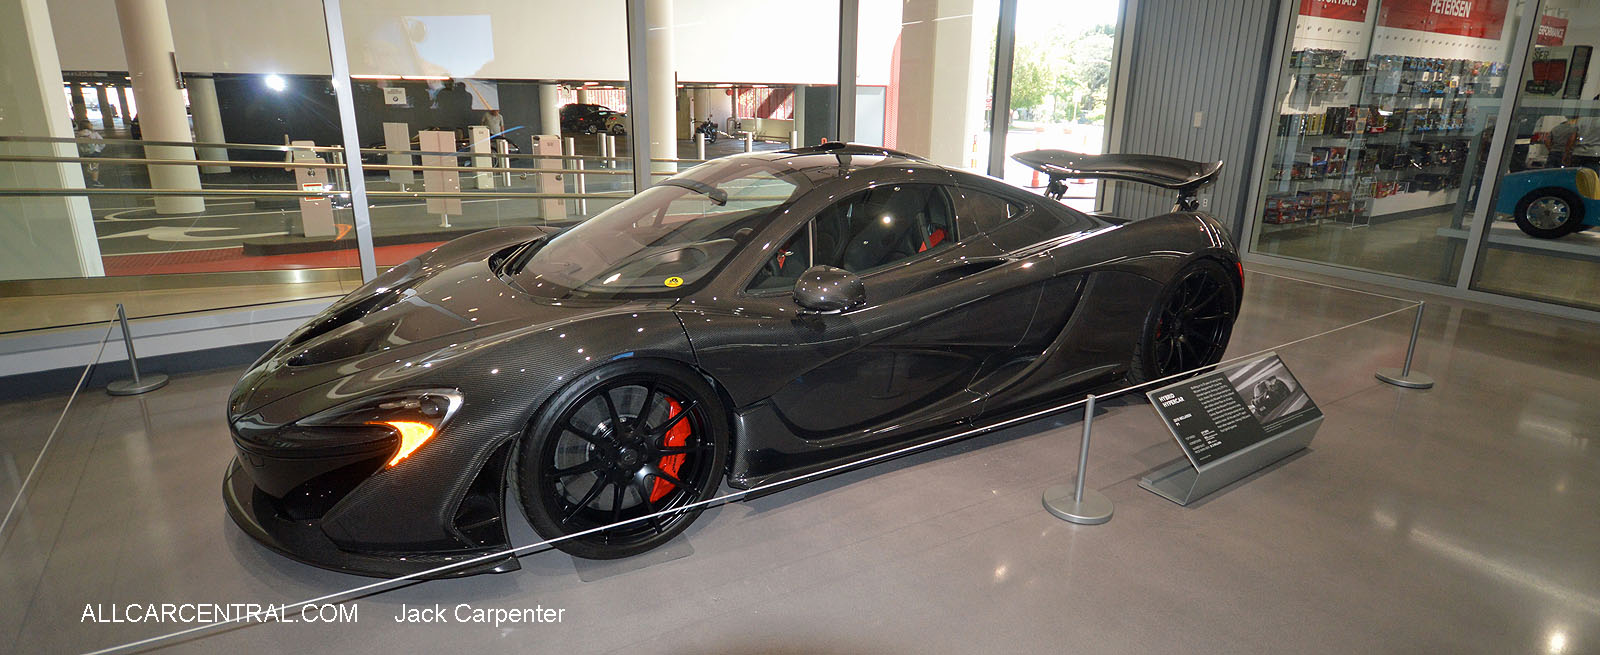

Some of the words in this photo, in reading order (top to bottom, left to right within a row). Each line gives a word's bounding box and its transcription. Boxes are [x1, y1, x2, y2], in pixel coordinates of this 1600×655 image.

[1429, 0, 1472, 18] PETERSEN
[1538, 25, 1564, 38] ERFORMANCE
[1158, 393, 1175, 402] HYBRID
[1162, 396, 1185, 408] HYPERCAR
